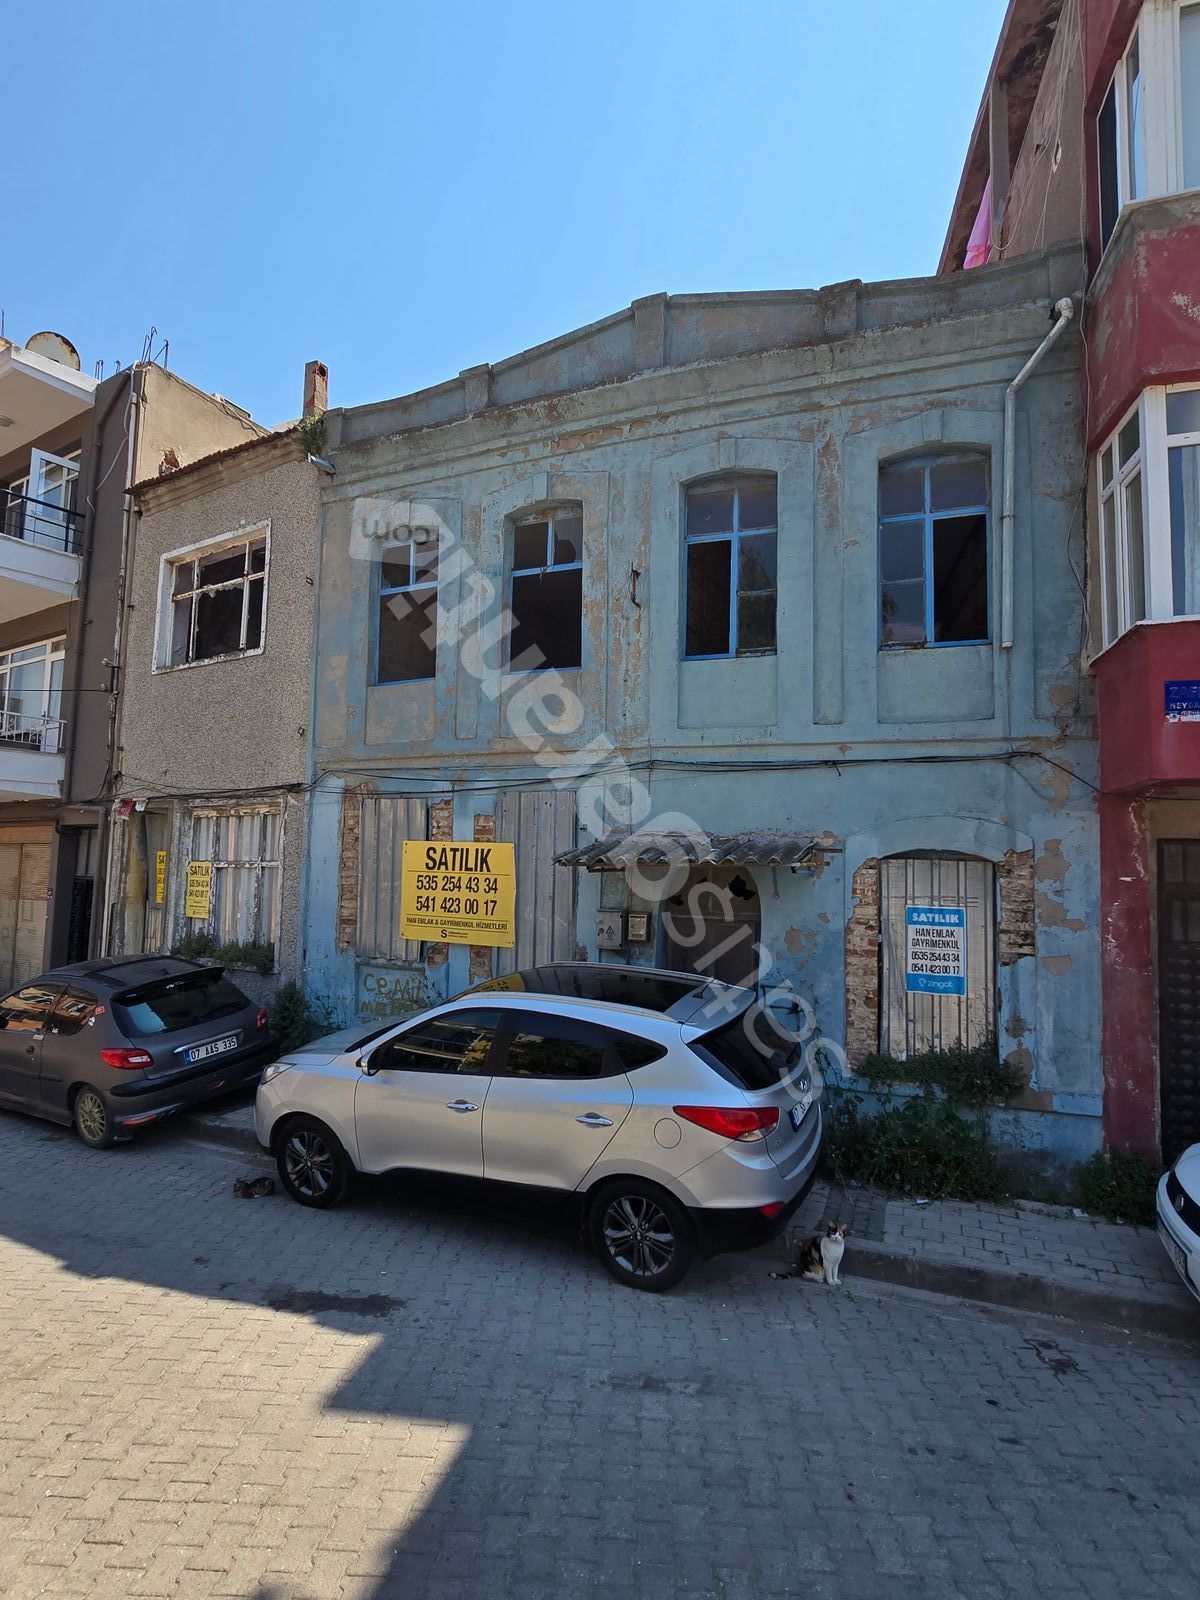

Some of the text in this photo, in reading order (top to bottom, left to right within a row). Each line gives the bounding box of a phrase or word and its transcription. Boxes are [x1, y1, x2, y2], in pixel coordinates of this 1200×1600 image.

[425, 847, 492, 873] SATILIK
[190, 865, 210, 877] SATILIK
[416, 875, 498, 894] 535 254 43 34
[416, 896, 497, 916] 541 423 00 17
[912, 912, 960, 923] SATILIK
[915, 928, 956, 938] HAN EMLAK
[190, 1037, 236, 1060] 07 AAS 335
